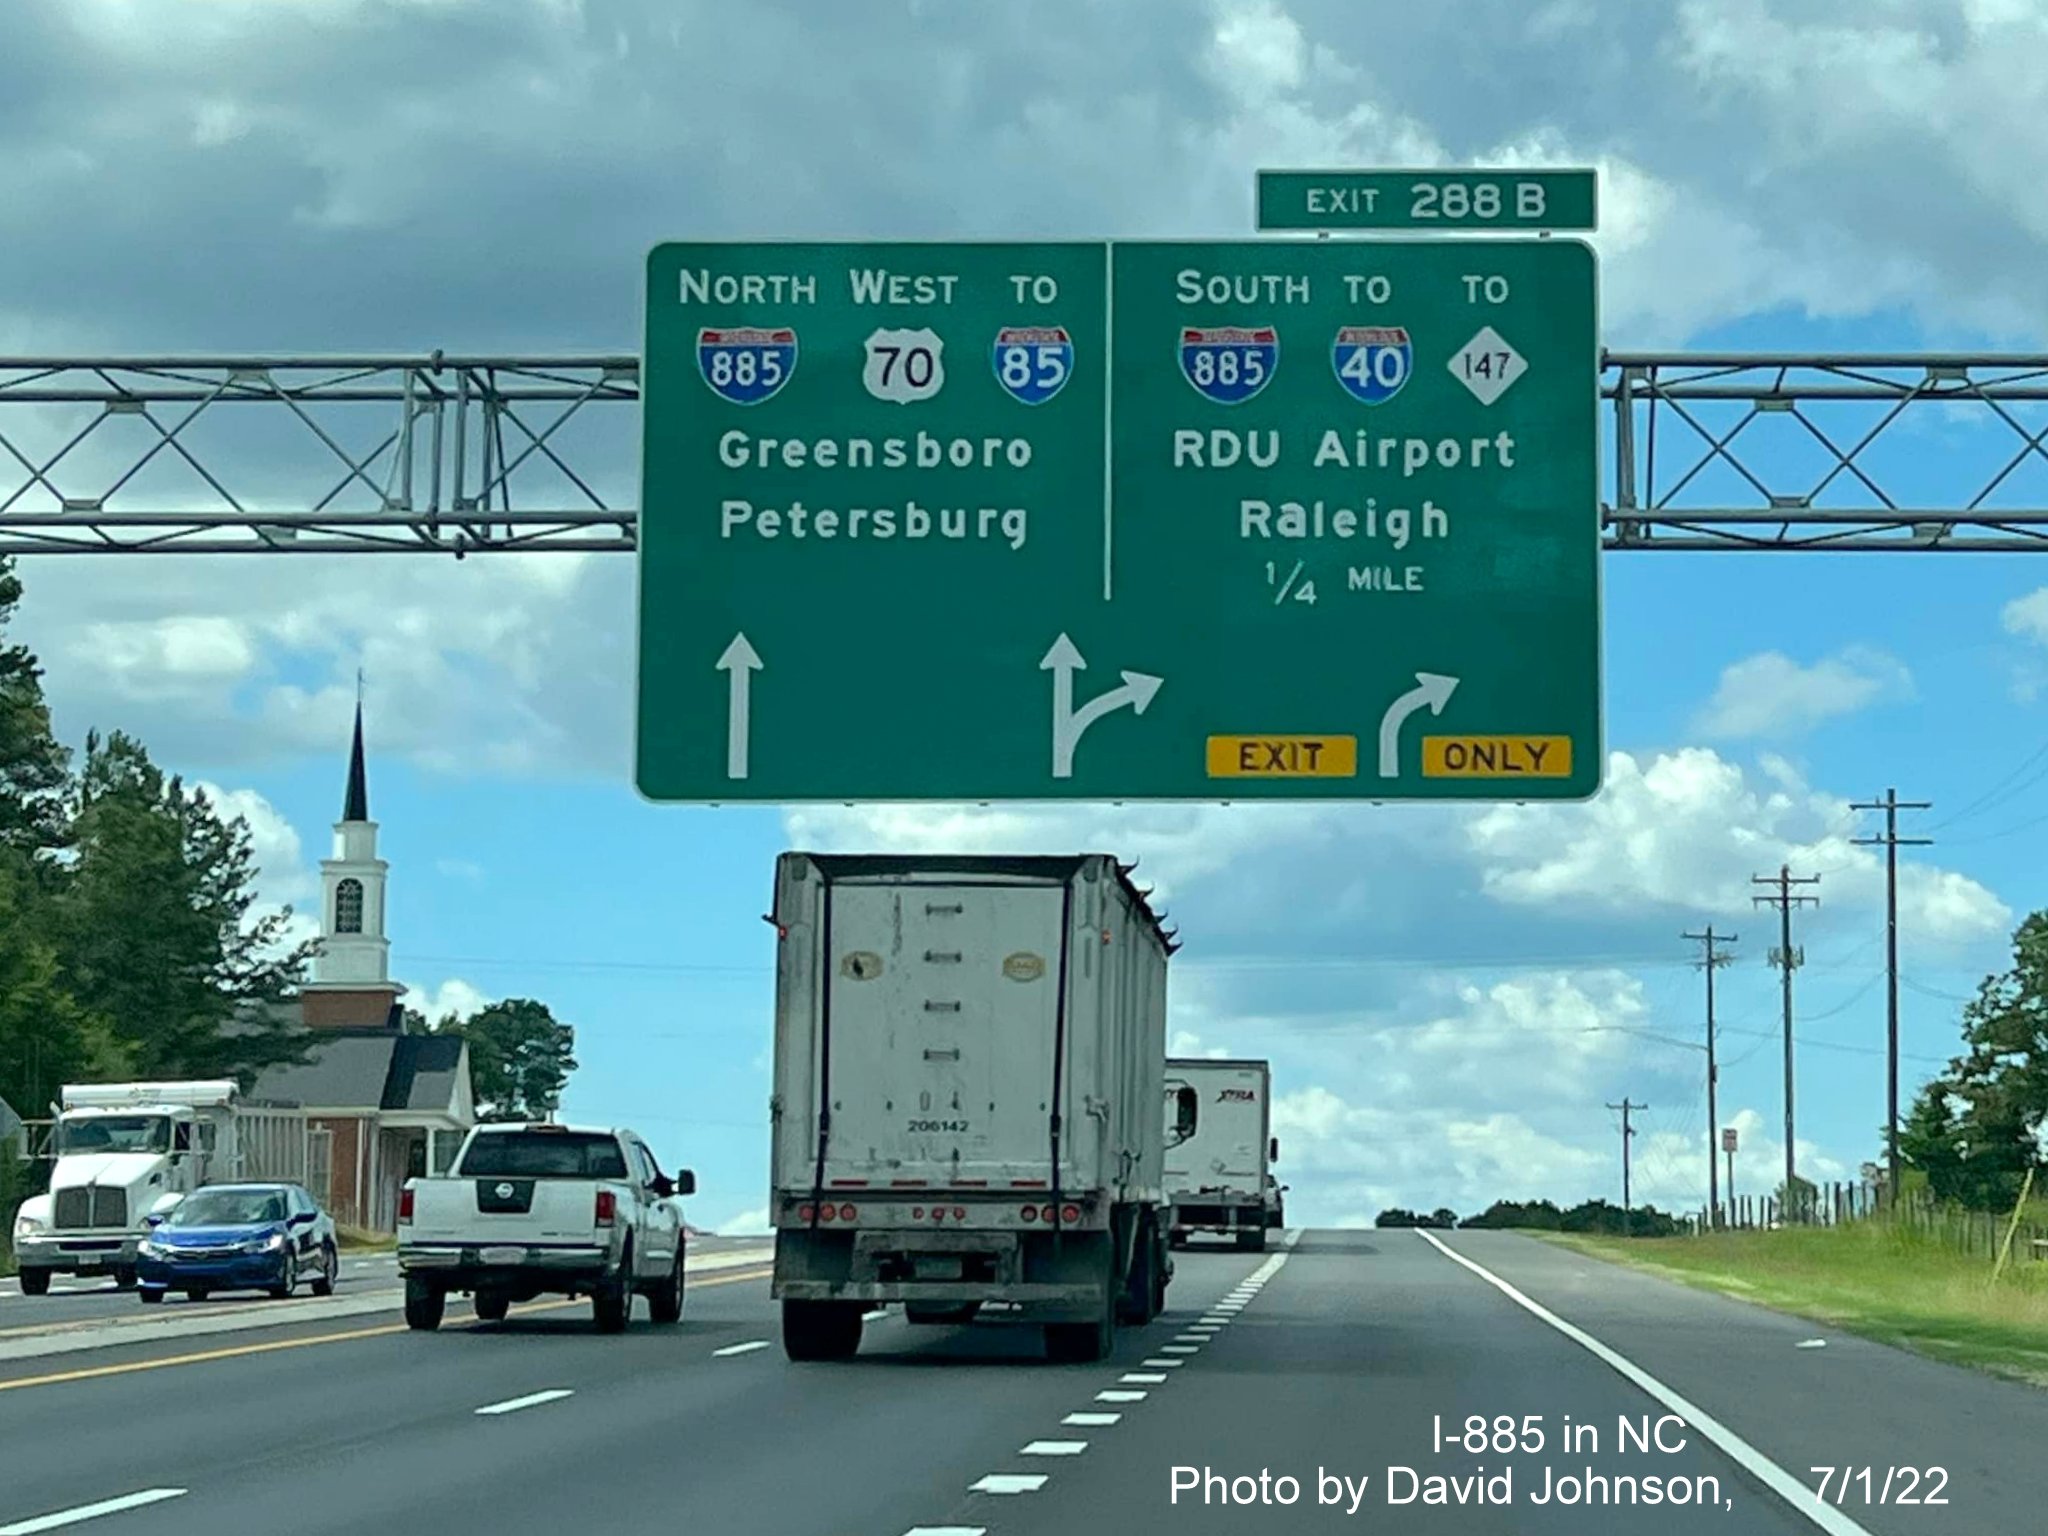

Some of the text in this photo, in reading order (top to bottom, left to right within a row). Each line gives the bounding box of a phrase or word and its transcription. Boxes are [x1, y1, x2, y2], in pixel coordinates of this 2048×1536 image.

[1307, 183, 1546, 218] EXIT 288 B
[679, 269, 1057, 304] NORTH WEST TO
[1176, 269, 1509, 304] SOUTH TO TO
[711, 346, 1065, 389] 885 70 85
[1194, 346, 1510, 389] 885 40 147
[719, 430, 1032, 468] Greensboro
[1174, 429, 1514, 477] RDU Airport
[721, 500, 1028, 550] Petersburg
[1241, 498, 1448, 550] Raleigh
[1348, 566, 1423, 591] MILE
[1239, 742, 1548, 772] EXIT ONLY
[907, 1120, 970, 1133] 206142
